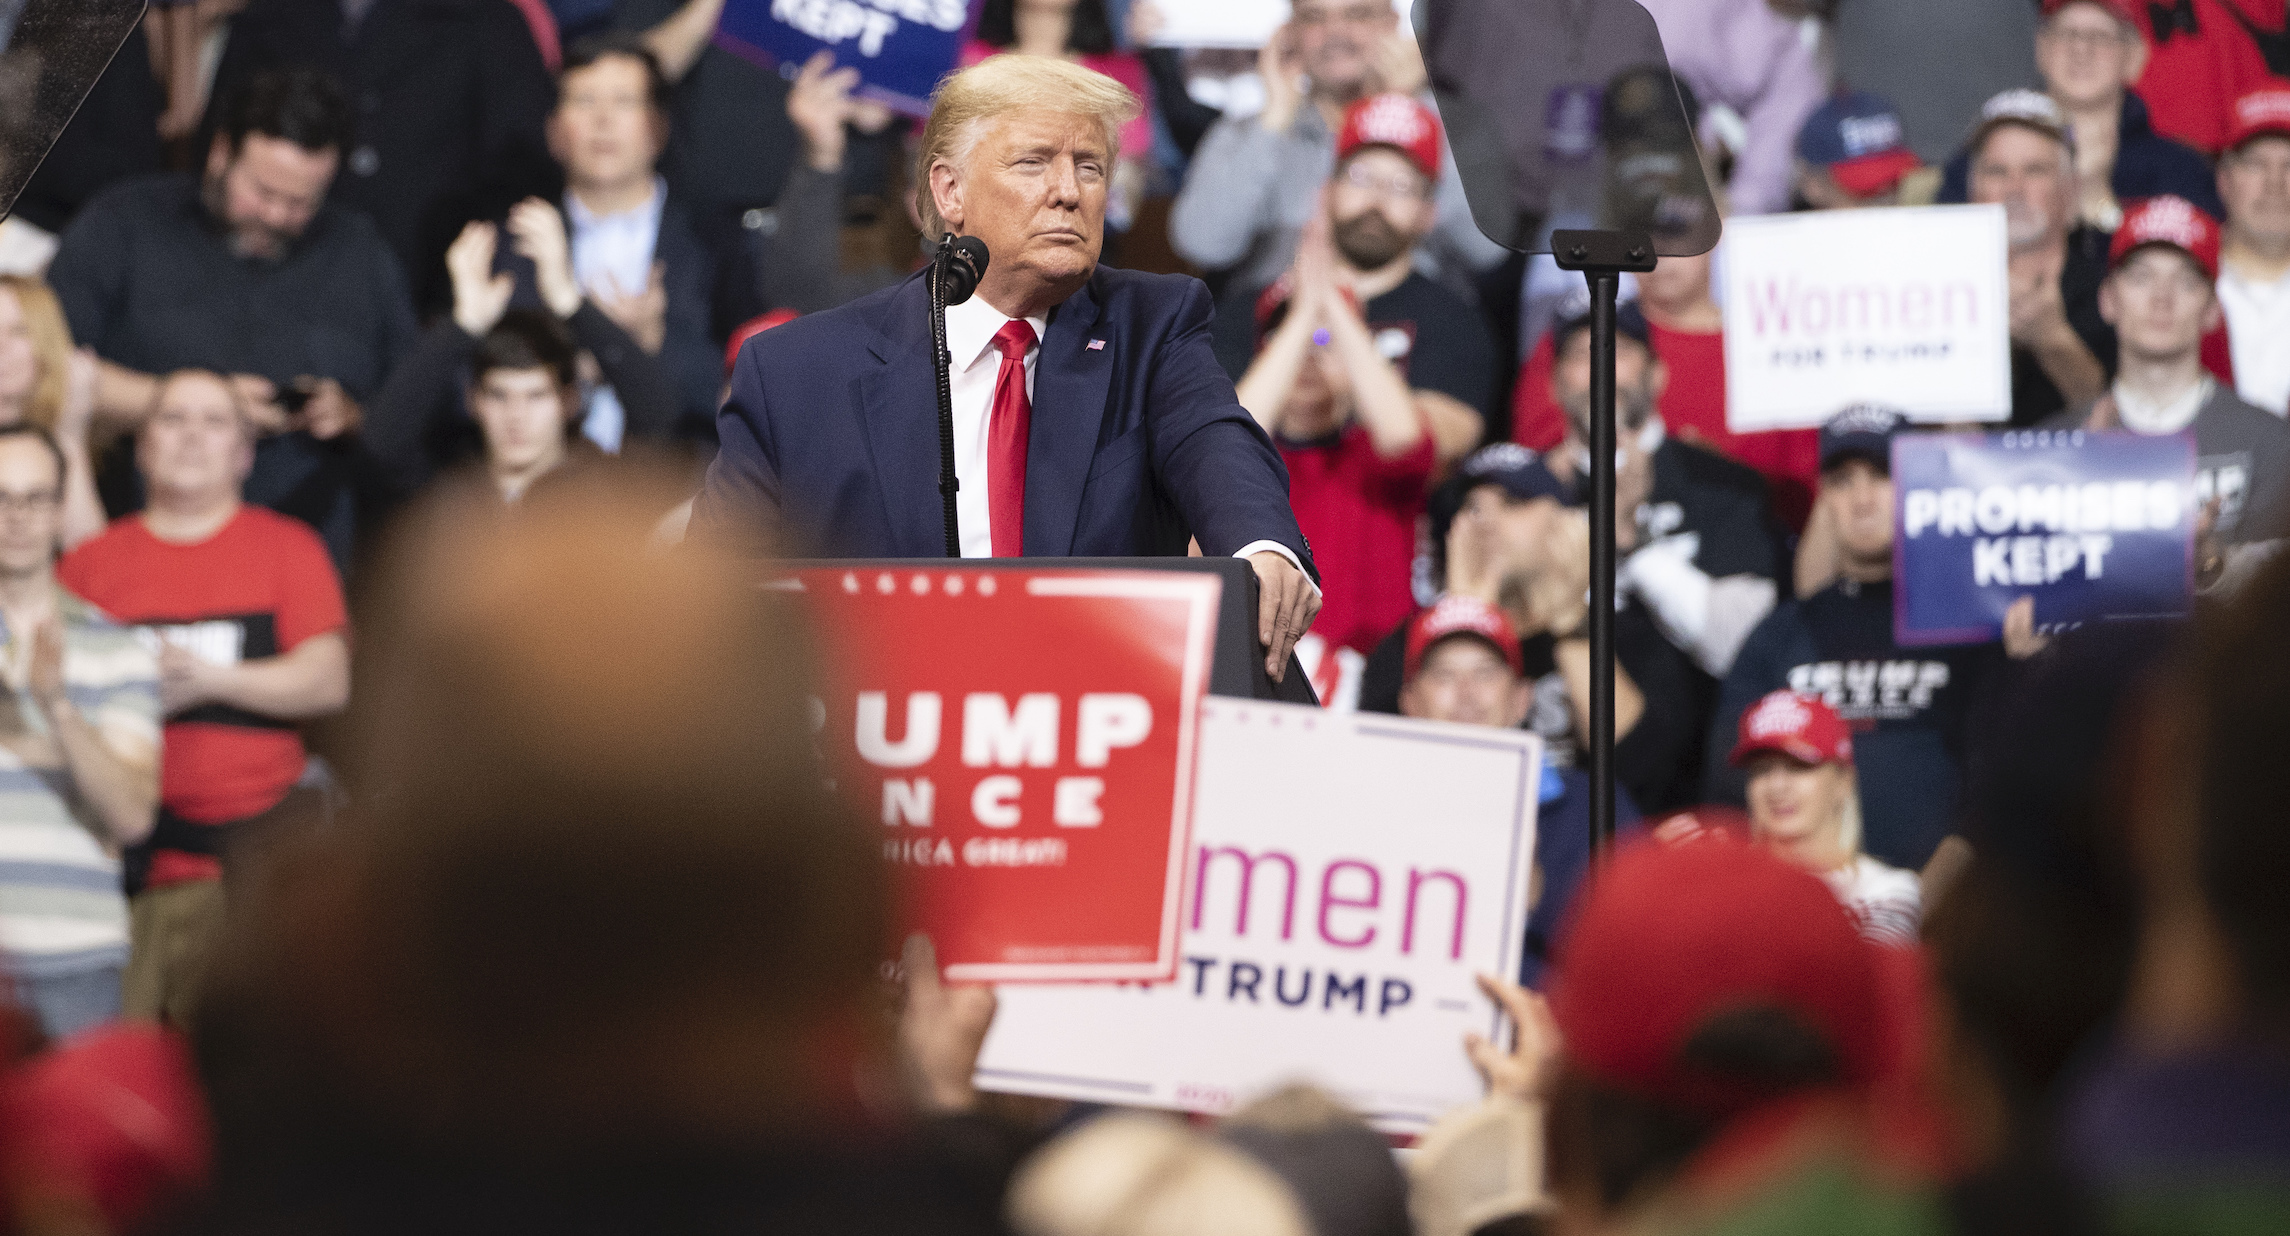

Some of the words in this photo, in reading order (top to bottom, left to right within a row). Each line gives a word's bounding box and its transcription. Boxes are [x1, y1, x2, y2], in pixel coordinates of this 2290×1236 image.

[1747, 275, 1978, 337] Women
[1769, 346, 1828, 369] FOR
[1840, 341, 1954, 364] TRUMP
[1904, 481, 2183, 539] PROMISES
[1973, 535, 2113, 587] KEPT
[850, 691, 1154, 768] UMP
[880, 776, 1106, 828] NCE
[1190, 845, 1469, 961] men
[1186, 956, 1414, 1018] TRUMP
